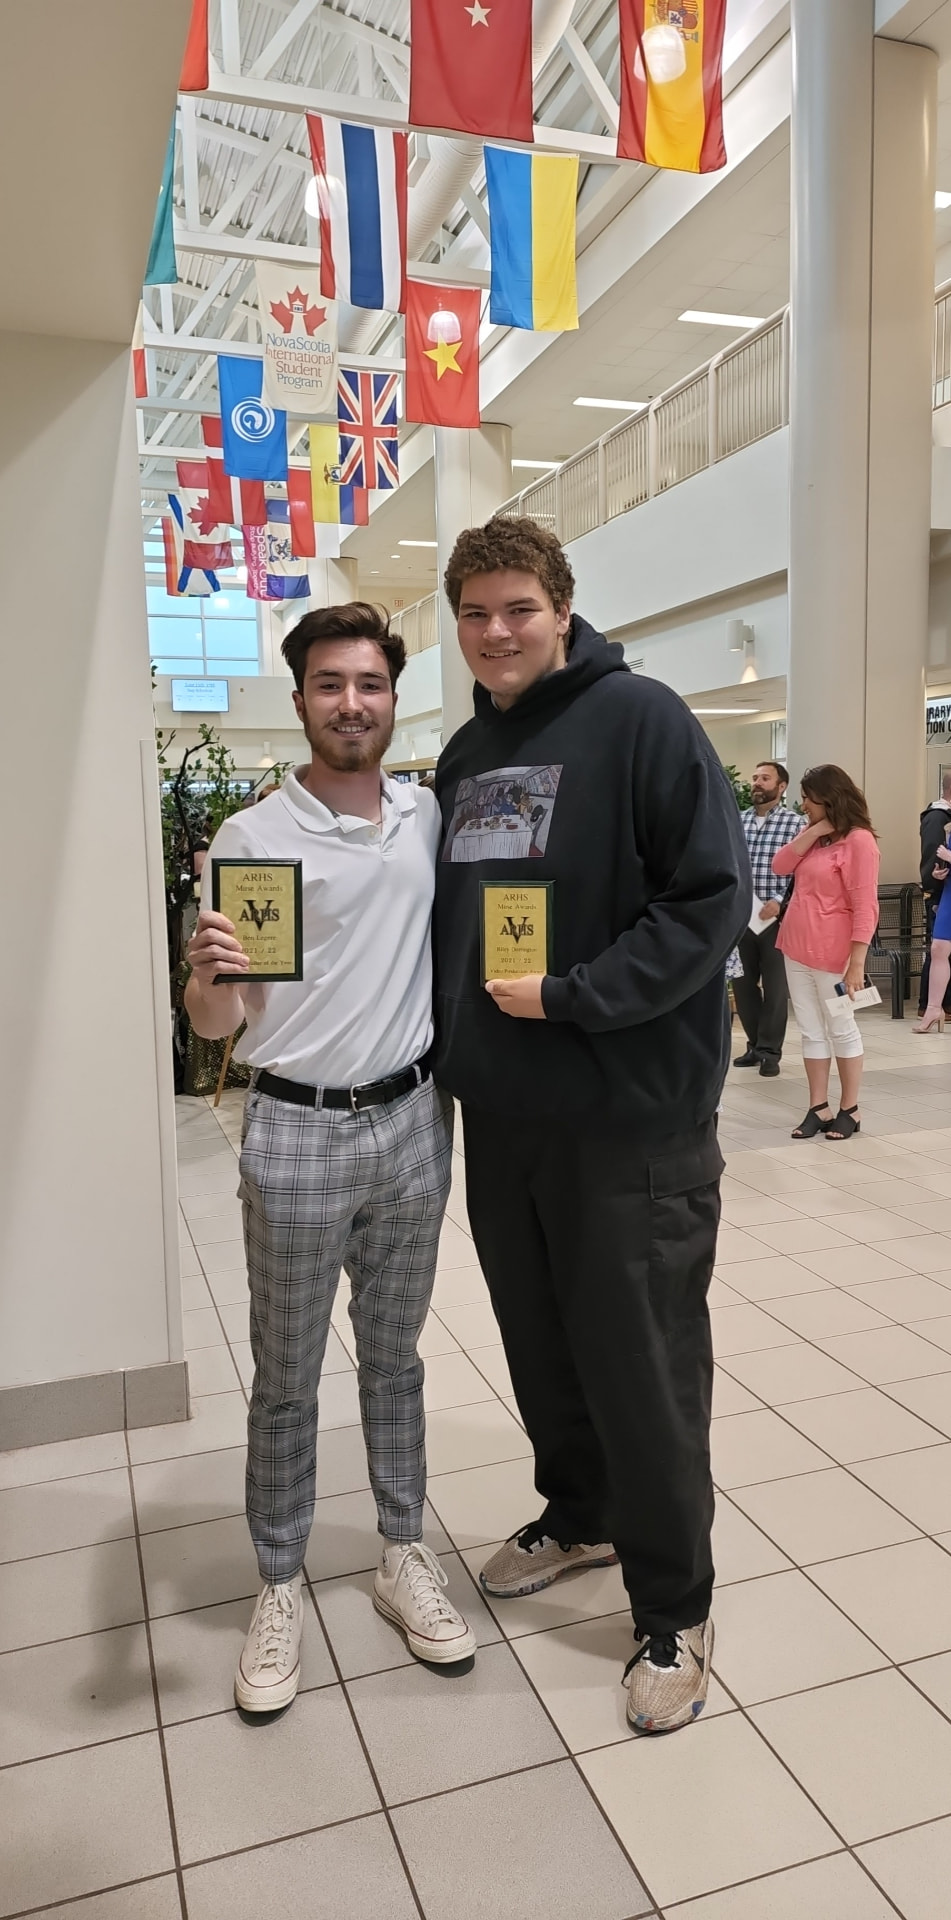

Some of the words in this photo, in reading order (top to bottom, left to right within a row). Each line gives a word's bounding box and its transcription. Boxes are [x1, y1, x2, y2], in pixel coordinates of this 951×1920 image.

[265, 344, 335, 365] International
[276, 361, 322, 377] Student
[277, 374, 323, 389] Program
[242, 873, 273, 882] ARHS
[503, 893, 528, 901] ARHS
[238, 908, 280, 921] ARHS
[499, 924, 534, 936] ARHS
